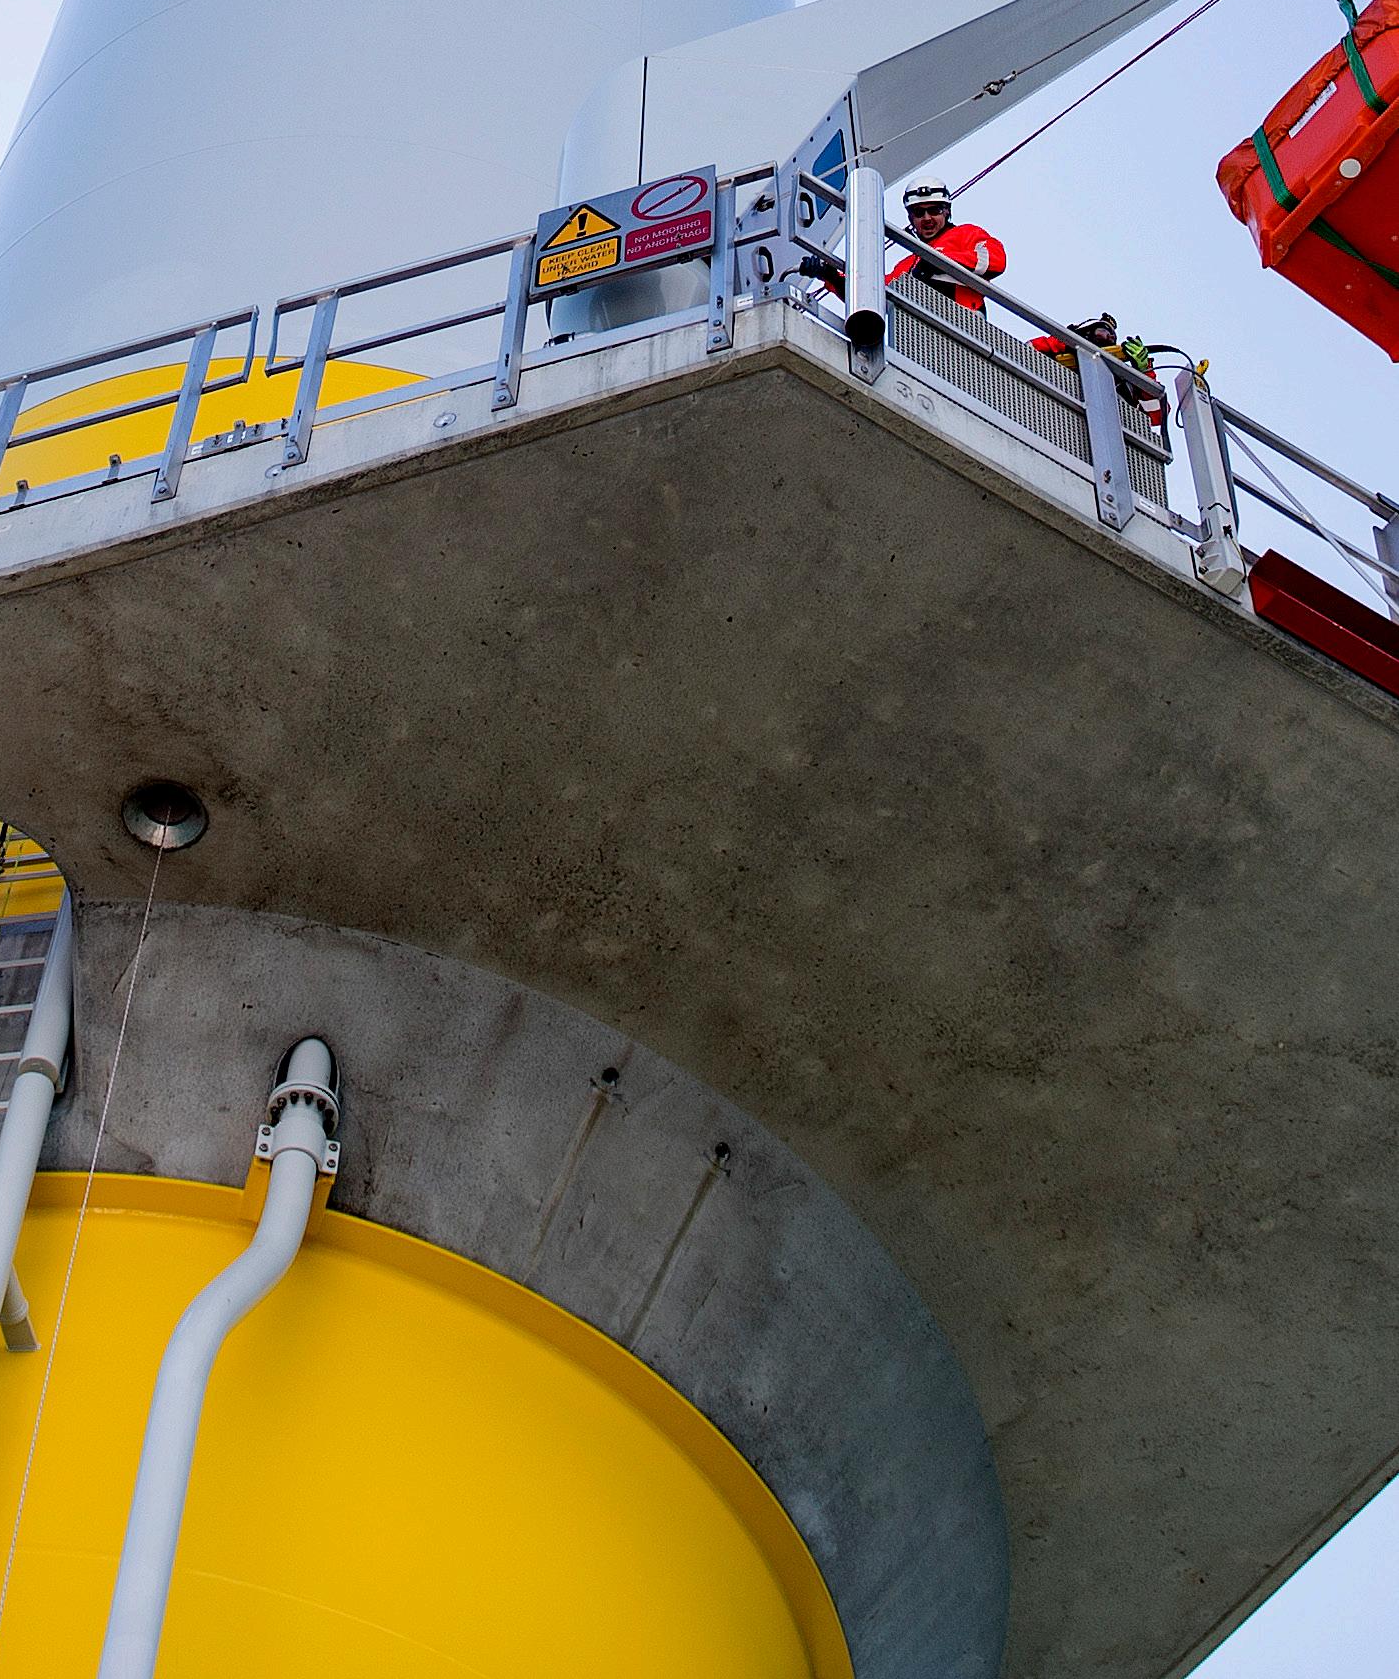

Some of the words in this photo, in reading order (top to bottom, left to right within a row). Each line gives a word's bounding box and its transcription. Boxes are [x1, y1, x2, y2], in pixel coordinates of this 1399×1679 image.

[634, 234, 650, 244] NO
[652, 220, 701, 239] MOORING
[542, 259, 577, 274] UNDER
[580, 248, 615, 263] WATER
[548, 252, 575, 265] KEEP
[577, 242, 610, 257] CLEAR
[626, 245, 642, 255] NO
[557, 260, 599, 277] HAZARD
